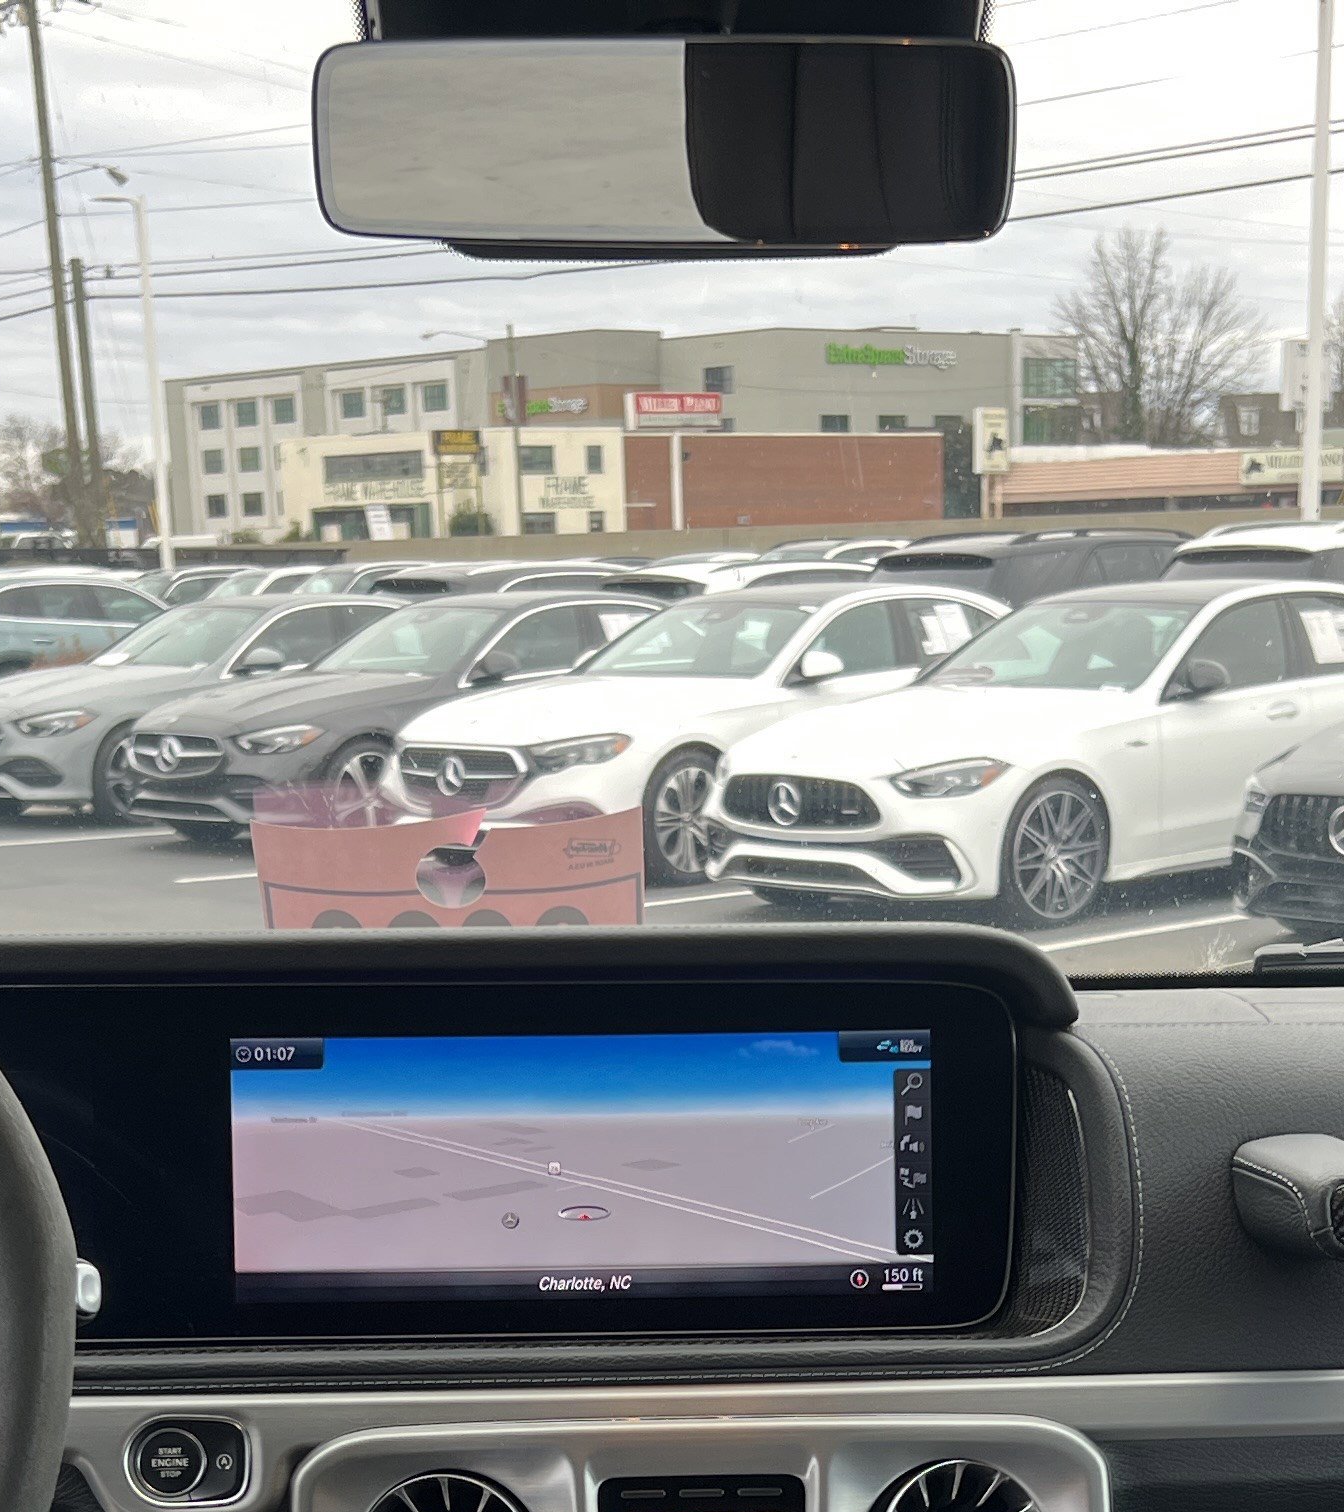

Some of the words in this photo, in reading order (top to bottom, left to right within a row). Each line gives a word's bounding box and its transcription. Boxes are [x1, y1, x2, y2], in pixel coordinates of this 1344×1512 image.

[254, 1046, 296, 1062] 01:07
[883, 1268, 910, 1283] 150
[912, 1268, 924, 1282] ft
[538, 1274, 605, 1293] Charlotte,
[609, 1275, 632, 1290] NC
[158, 1447, 183, 1456] START
[150, 1457, 190, 1469] ENGINE
[159, 1469, 183, 1479] STOP
